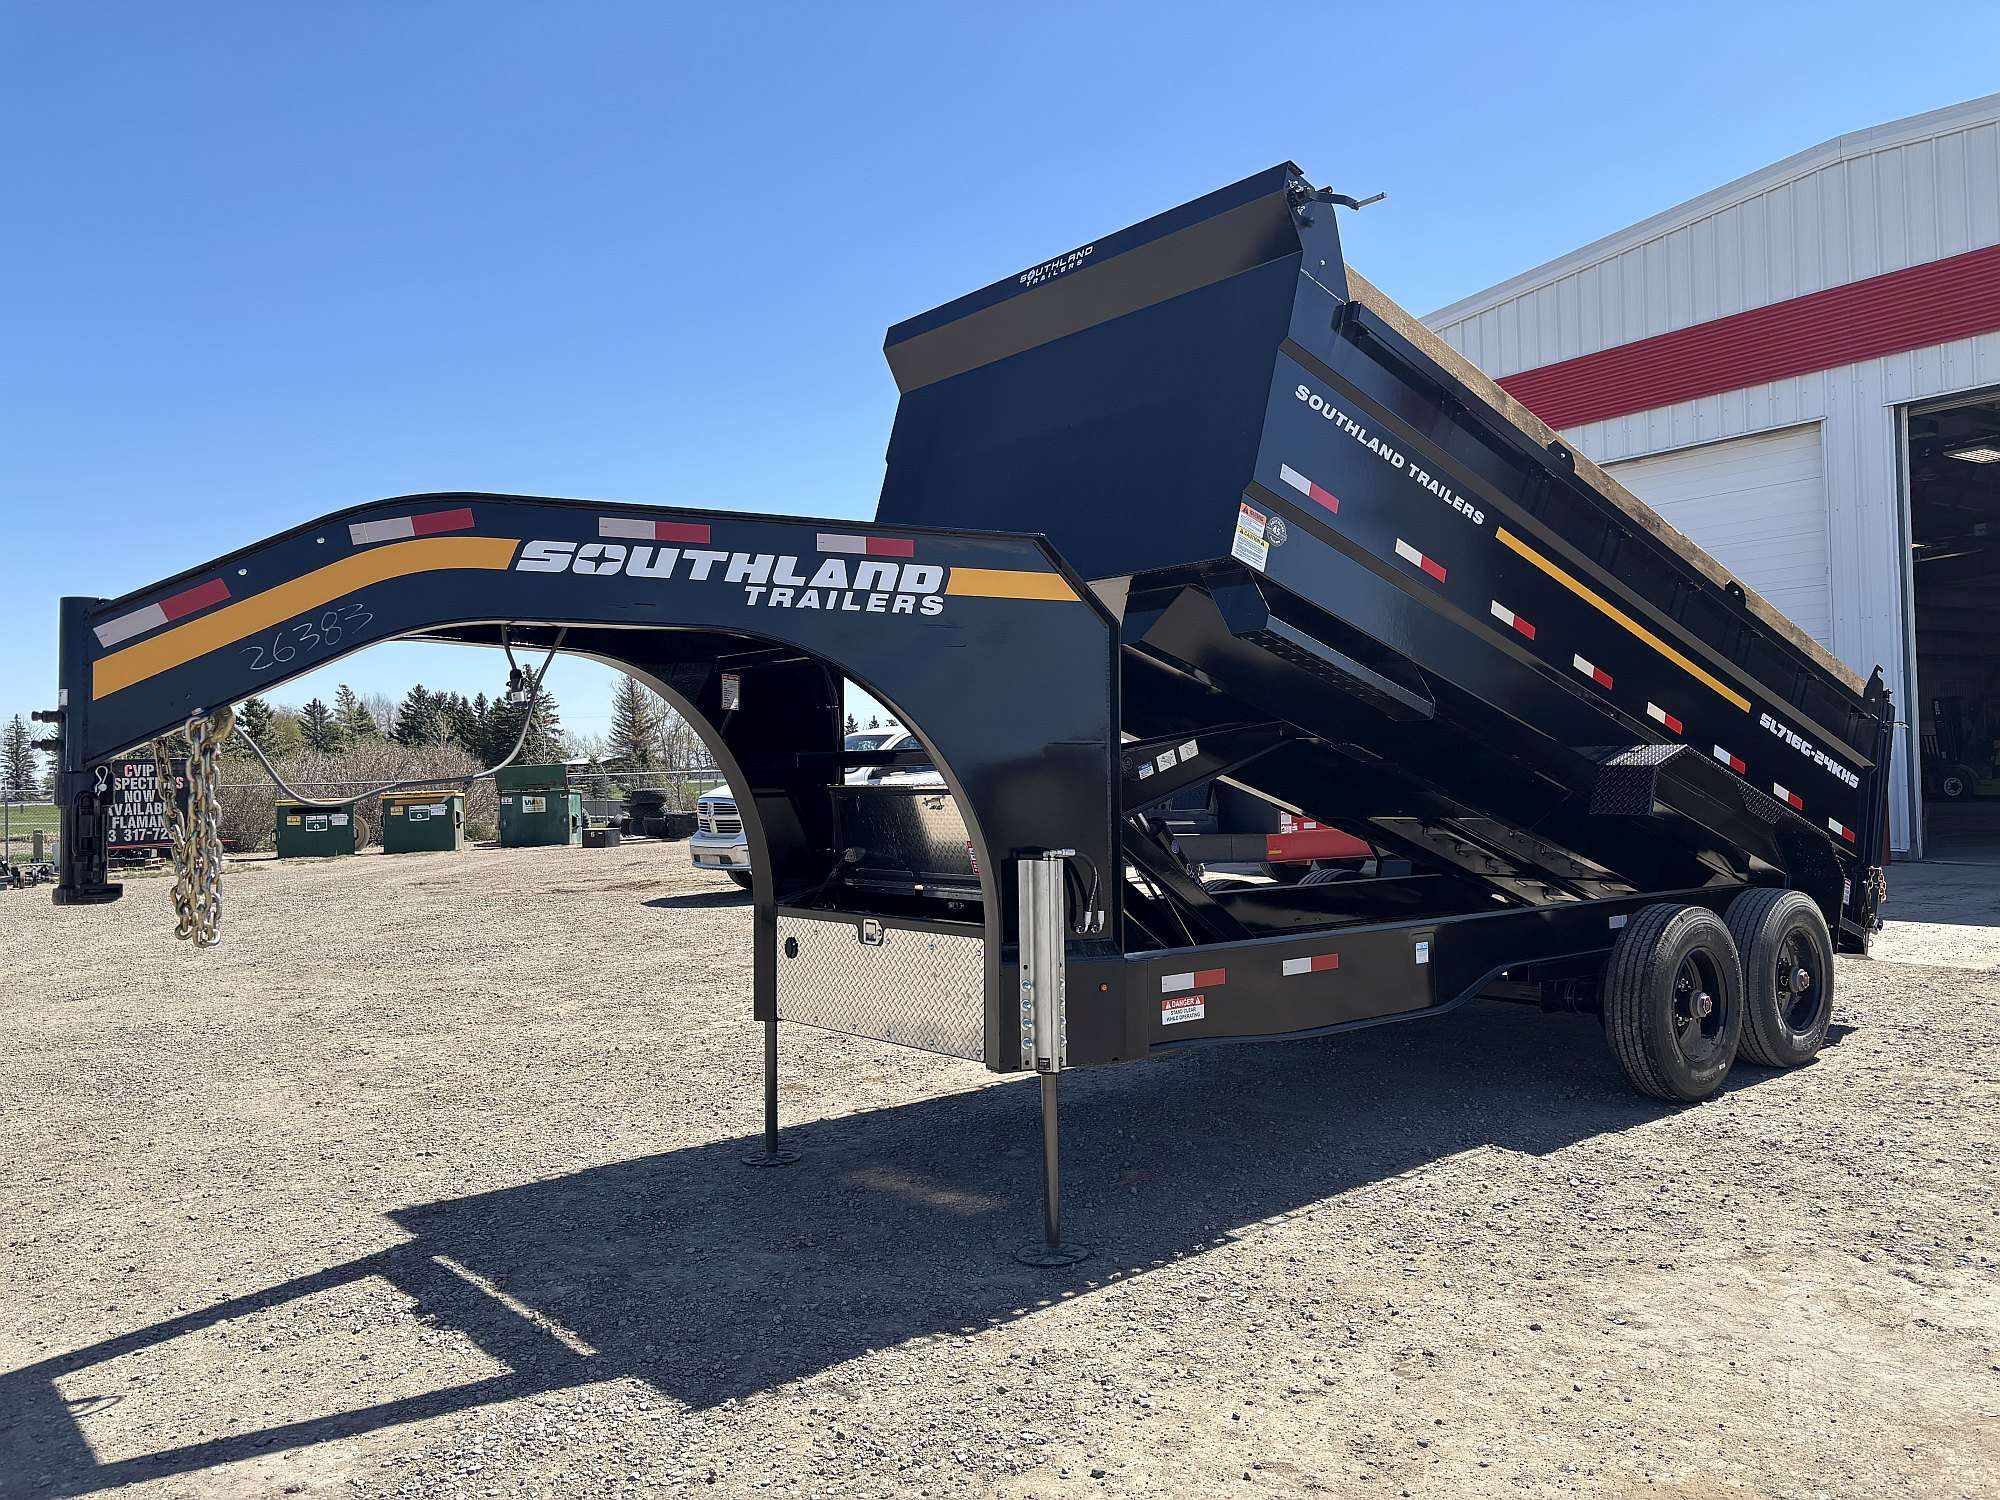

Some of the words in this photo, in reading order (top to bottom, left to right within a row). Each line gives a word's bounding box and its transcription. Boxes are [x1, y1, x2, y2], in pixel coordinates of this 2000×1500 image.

[1019, 246, 1094, 283] SOUTHLAND
[1026, 259, 1083, 287] TRAILERS
[1295, 384, 1405, 469] SOUTHLAND
[1408, 462, 1485, 525] TRAILERS
[515, 539, 945, 595] SOUTHLAND
[744, 585, 945, 616] TRAILERS
[239, 603, 374, 670] 26383
[114, 777, 184, 790] SPECTIS
[124, 765, 154, 777] CVIP
[125, 790, 155, 802] NOW
[124, 829, 174, 842] 317-72
[1171, 998, 1195, 1007] DANGER
